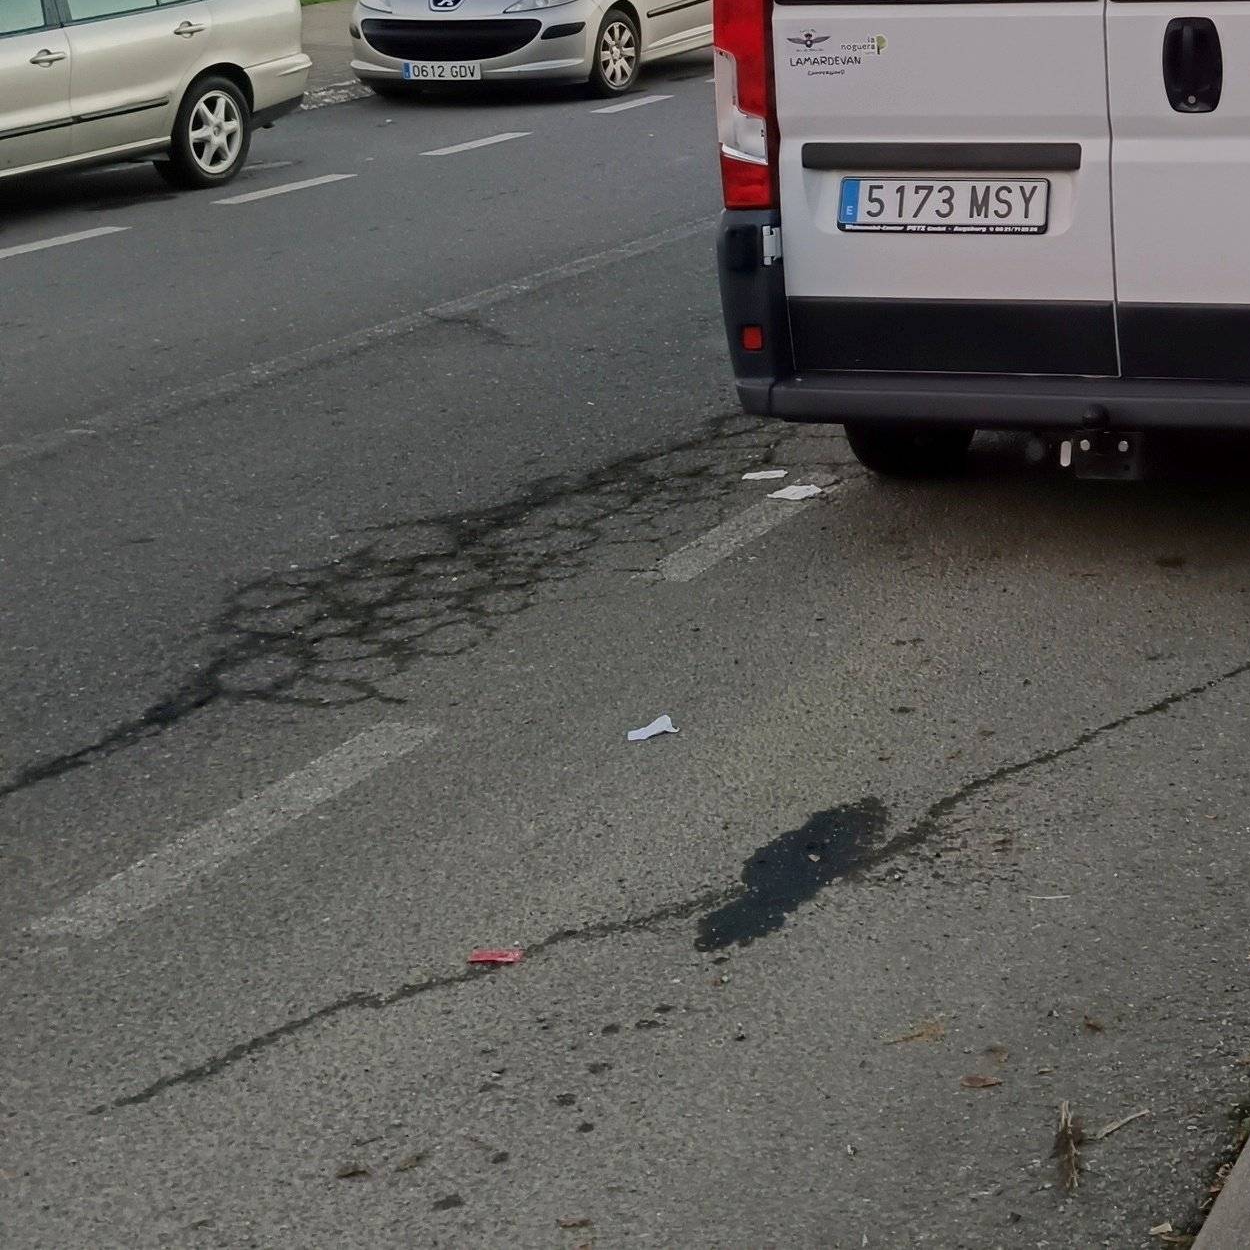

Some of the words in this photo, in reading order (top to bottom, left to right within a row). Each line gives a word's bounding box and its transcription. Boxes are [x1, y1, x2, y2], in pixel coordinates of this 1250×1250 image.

[840, 43, 876, 52] noguera
[789, 56, 861, 67] LAMARDEVAN
[412, 64, 445, 78] 0612
[450, 65, 475, 78] GDV
[866, 184, 955, 218] 5173
[969, 185, 1038, 219] MSY
